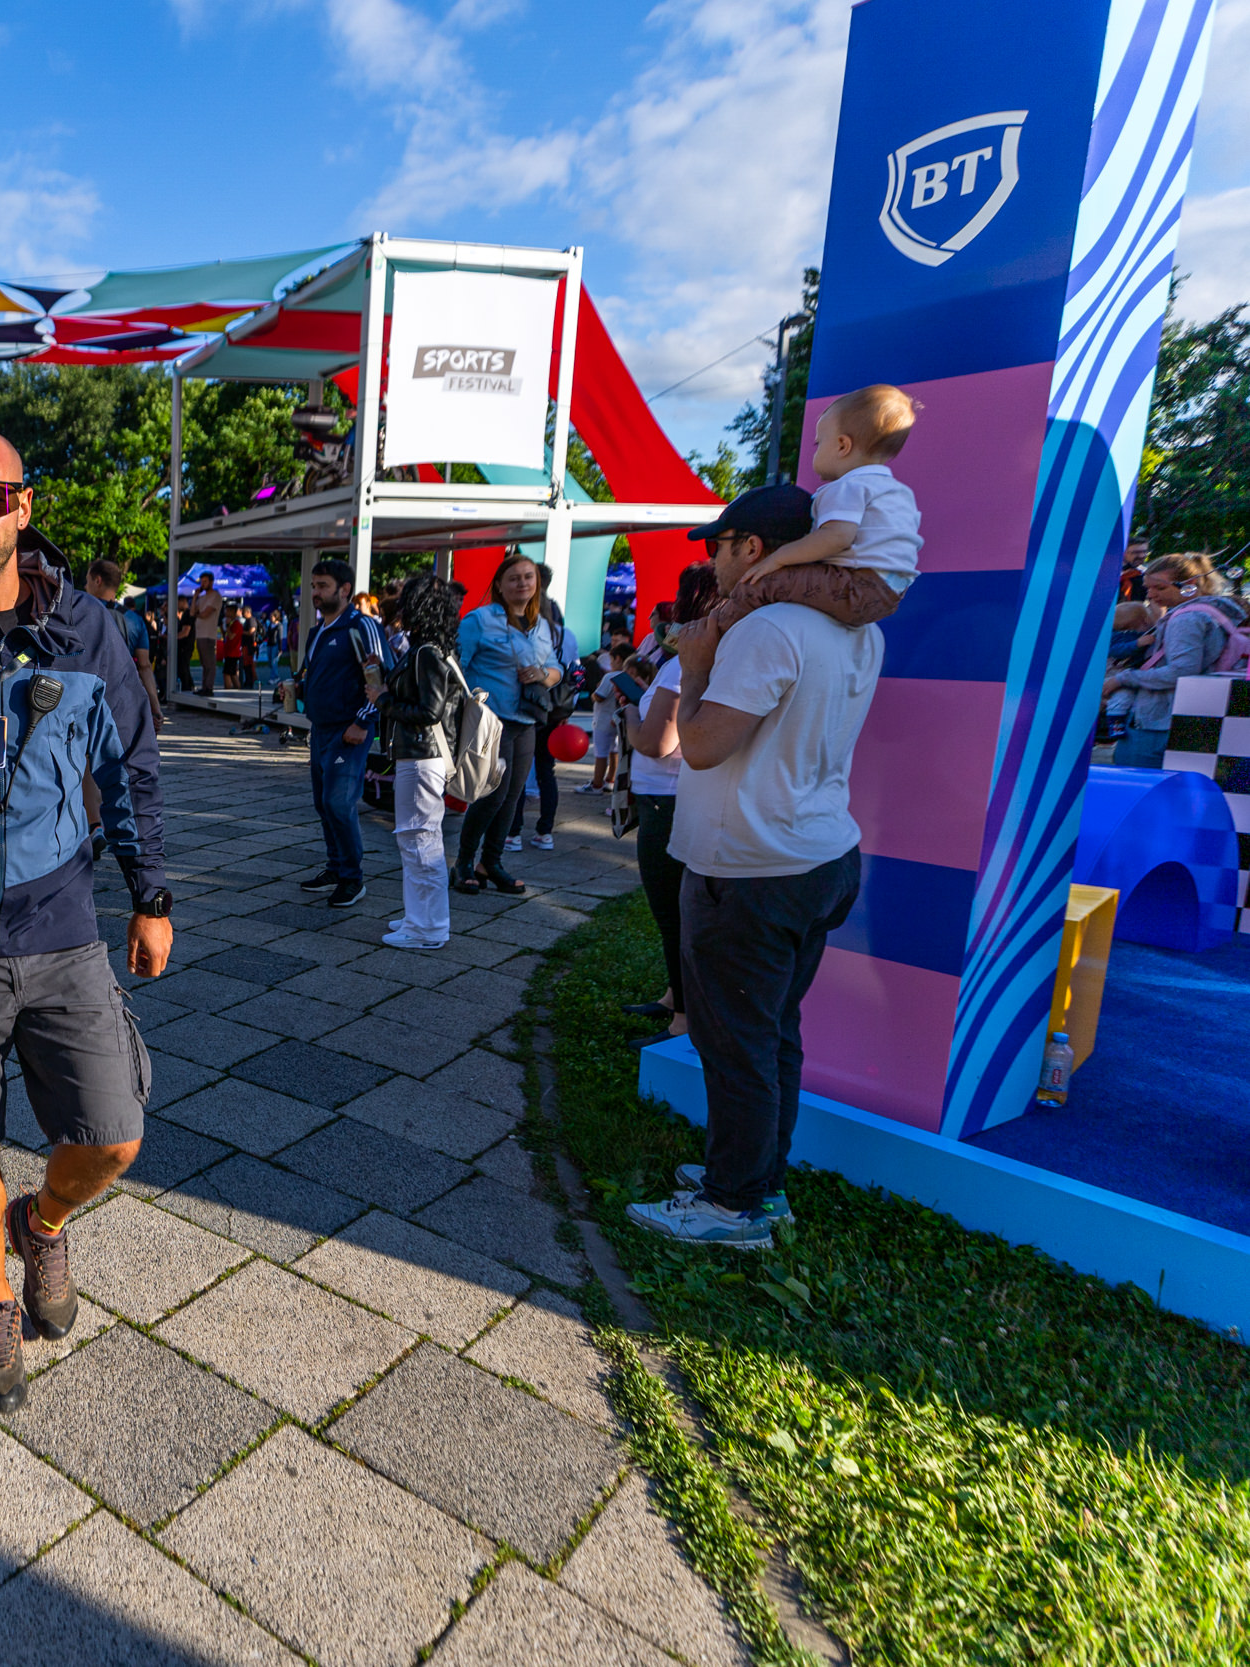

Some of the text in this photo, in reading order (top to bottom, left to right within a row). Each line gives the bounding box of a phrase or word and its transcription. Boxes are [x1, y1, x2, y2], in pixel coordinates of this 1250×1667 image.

[911, 146, 993, 209] BT
[423, 349, 505, 372] SPORTS
[449, 375, 515, 393] FESTIVAL
